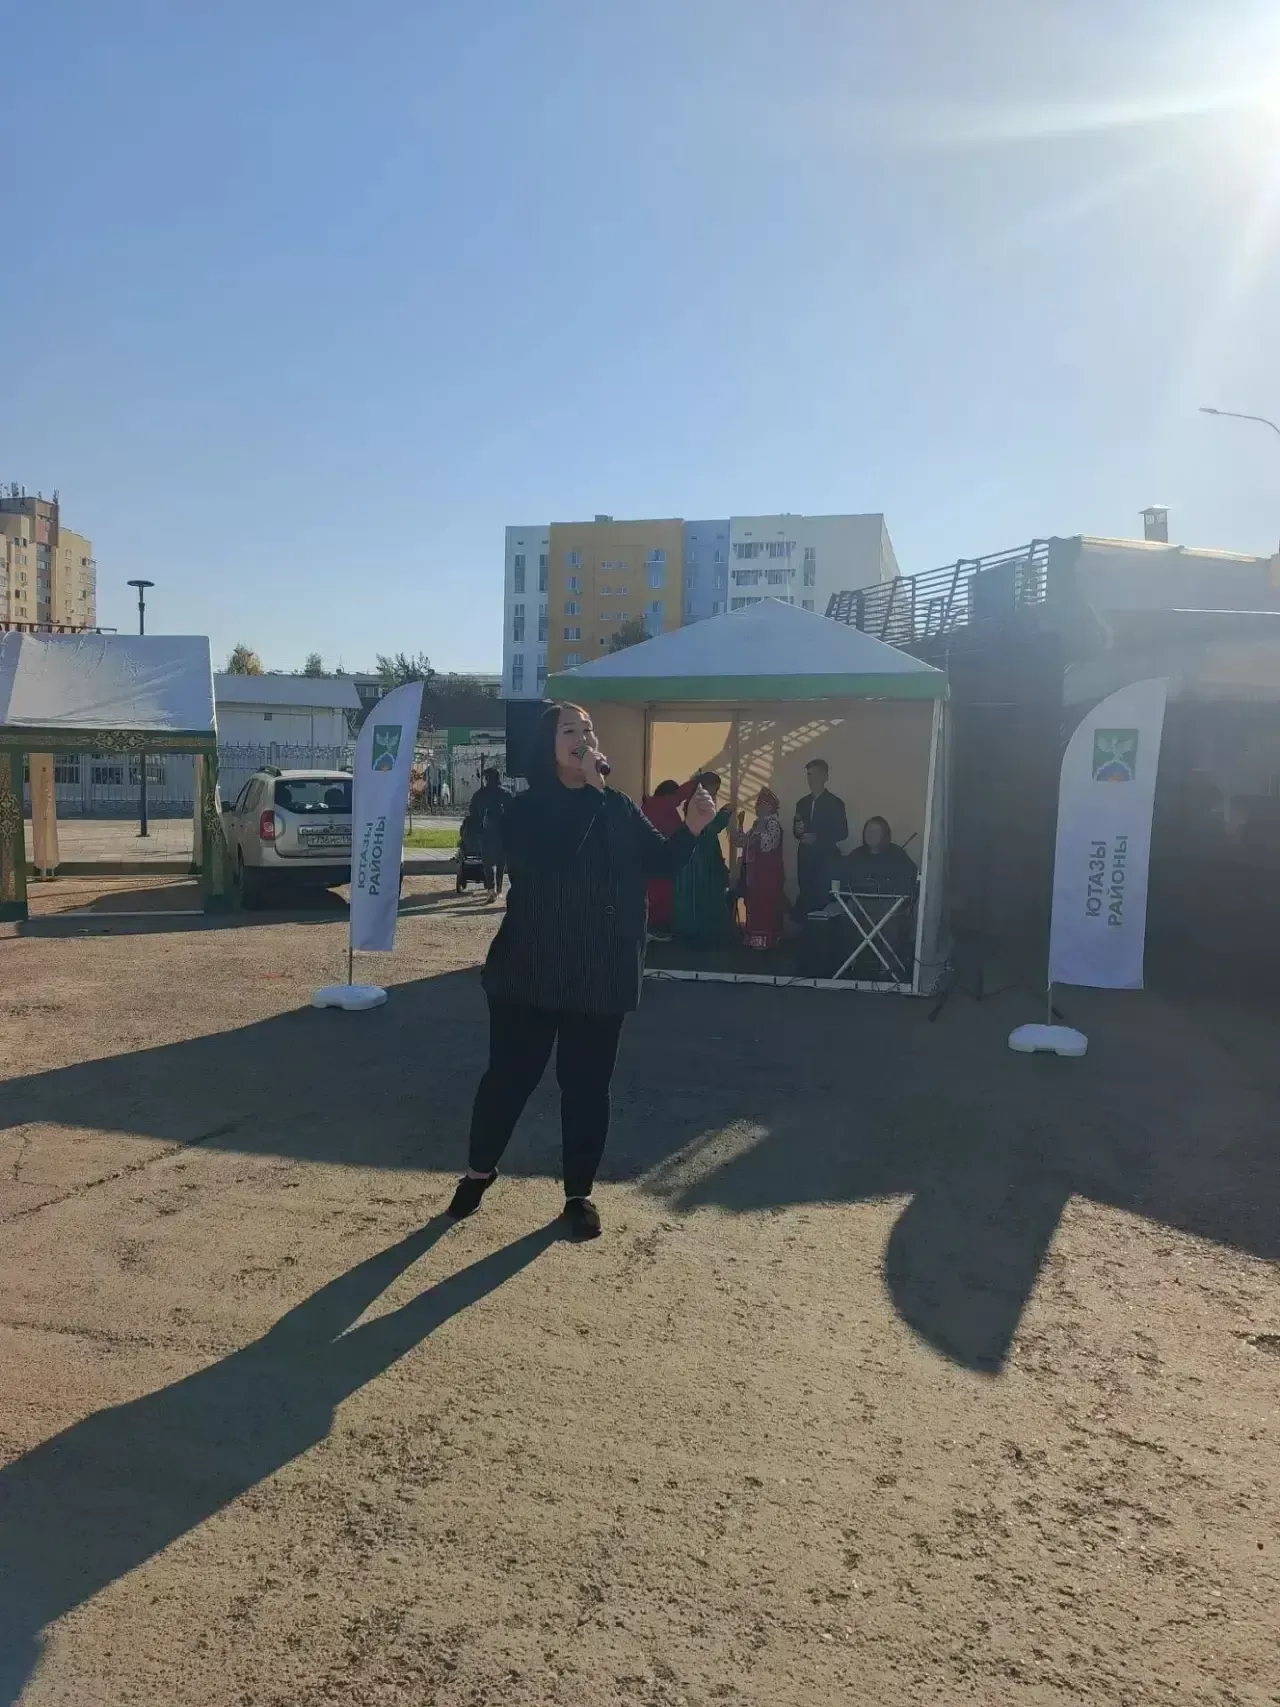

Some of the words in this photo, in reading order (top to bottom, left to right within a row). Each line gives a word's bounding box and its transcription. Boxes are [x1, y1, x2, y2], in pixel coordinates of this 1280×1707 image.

[358, 822, 374, 888] ЮТАЗЫ
[368, 816, 386, 896] РАЙОНЫ
[1085, 840, 1107, 917] ЮТАЗЫ
[1107, 835, 1128, 926] РАЙОНЫ
